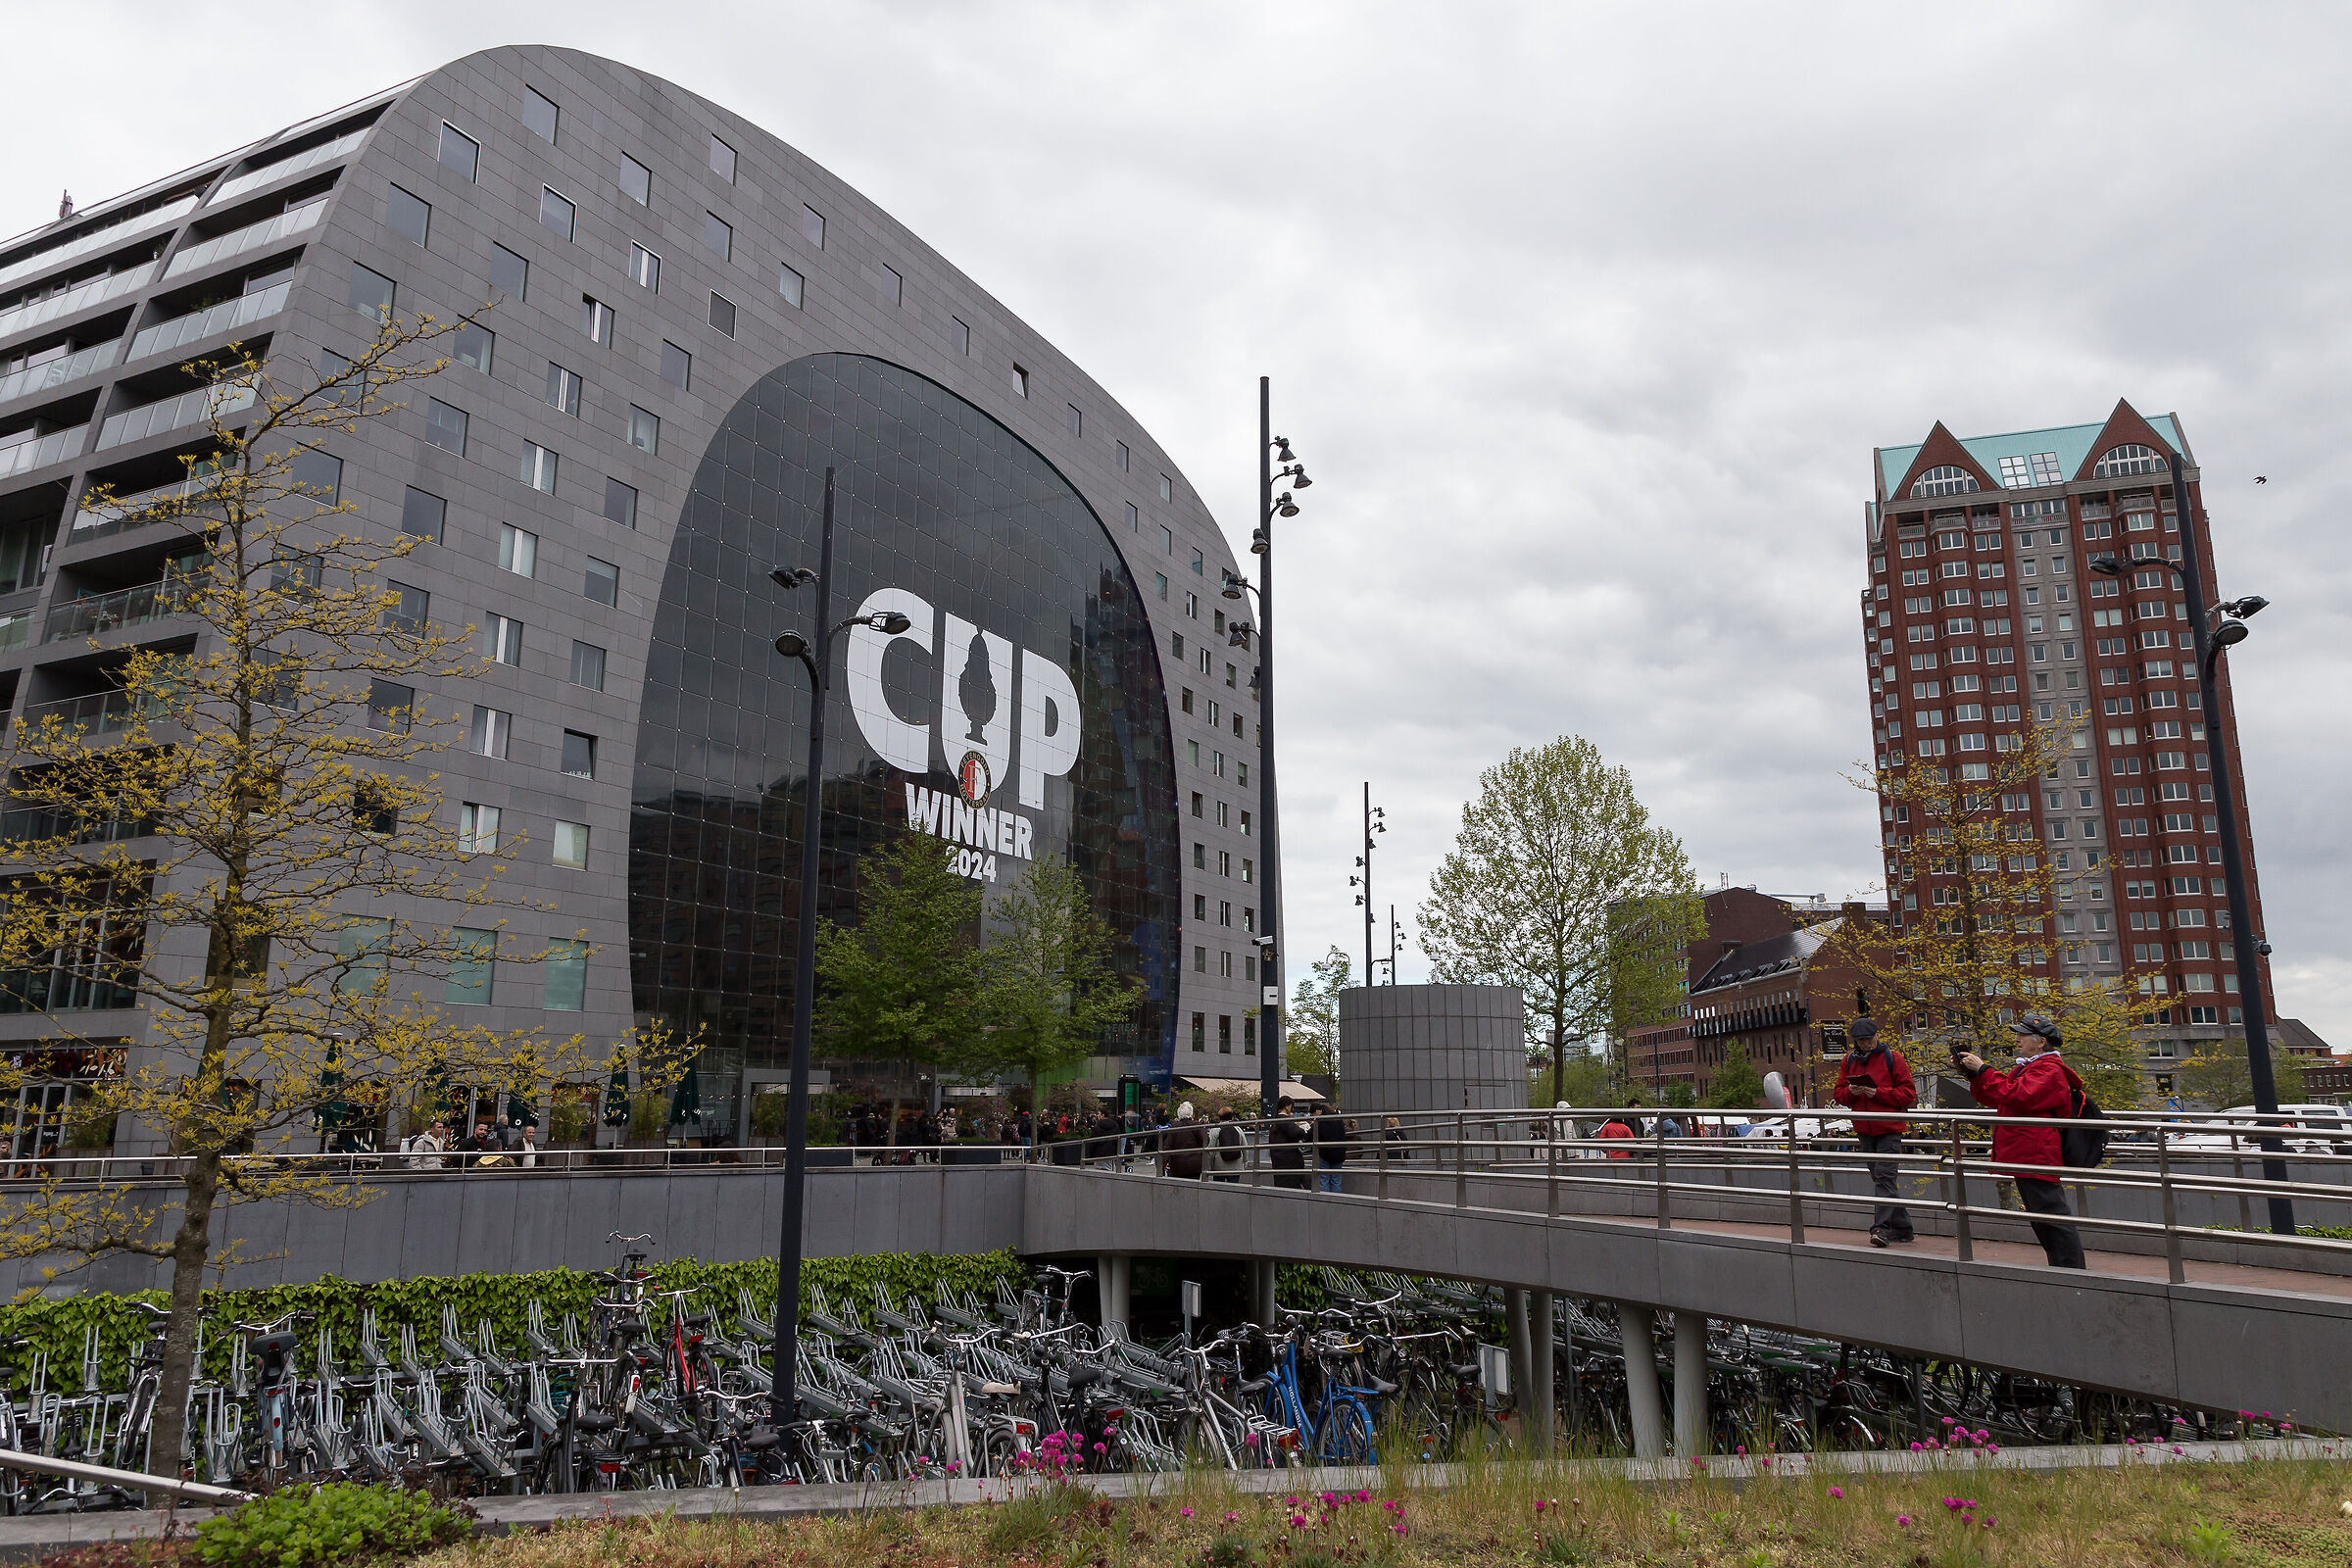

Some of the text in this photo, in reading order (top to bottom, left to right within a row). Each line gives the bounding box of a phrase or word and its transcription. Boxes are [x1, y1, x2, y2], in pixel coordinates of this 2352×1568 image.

[847, 587, 1081, 810] CUP
[961, 753, 989, 775] FEYENOORD
[960, 784, 989, 807] ROTTERDAM
[906, 782, 1033, 860] WINNER
[946, 845, 997, 883] 2024
[1289, 1386, 1301, 1428] HOLLANDIA
